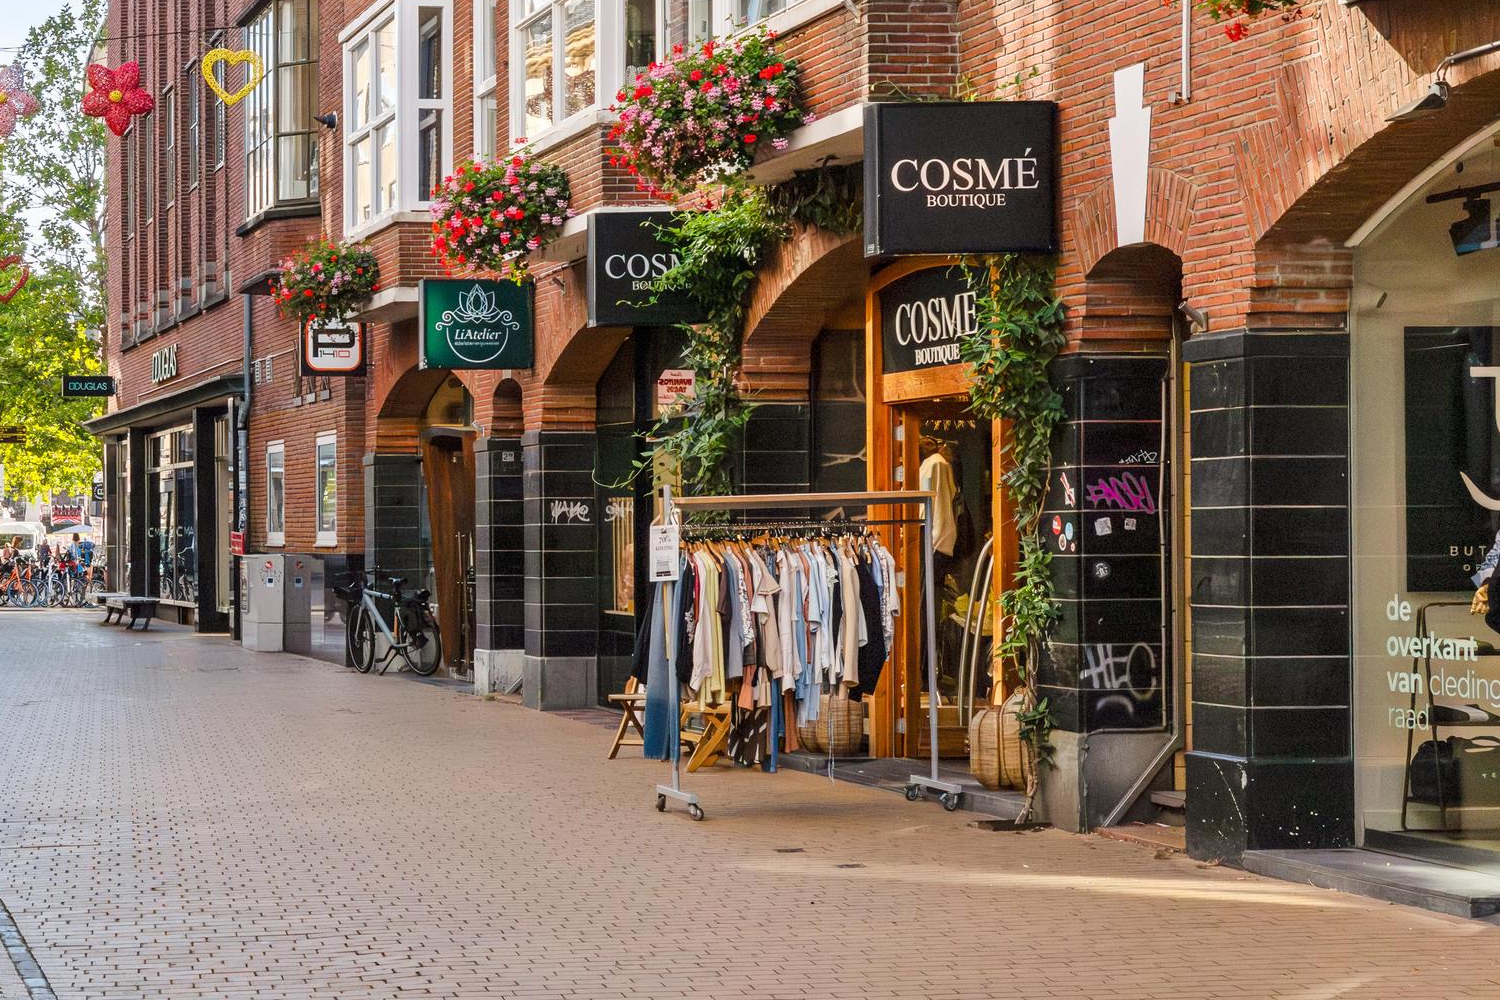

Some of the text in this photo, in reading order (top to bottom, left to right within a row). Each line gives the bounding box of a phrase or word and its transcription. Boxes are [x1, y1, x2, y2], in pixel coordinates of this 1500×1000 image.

[891, 148, 1039, 191] COSMÉ
[927, 194, 1006, 209] BOUTIQUE
[454, 328, 501, 340] LiAtelier
[152, 344, 177, 384] DOUGLAS
[915, 343, 960, 365] BOUTIQUE
[68, 382, 108, 391] DOUGLAS
[1386, 593, 1411, 621] de
[1386, 631, 1478, 661] overkant
[1387, 671, 1423, 694] van
[1388, 703, 1429, 730] raad
